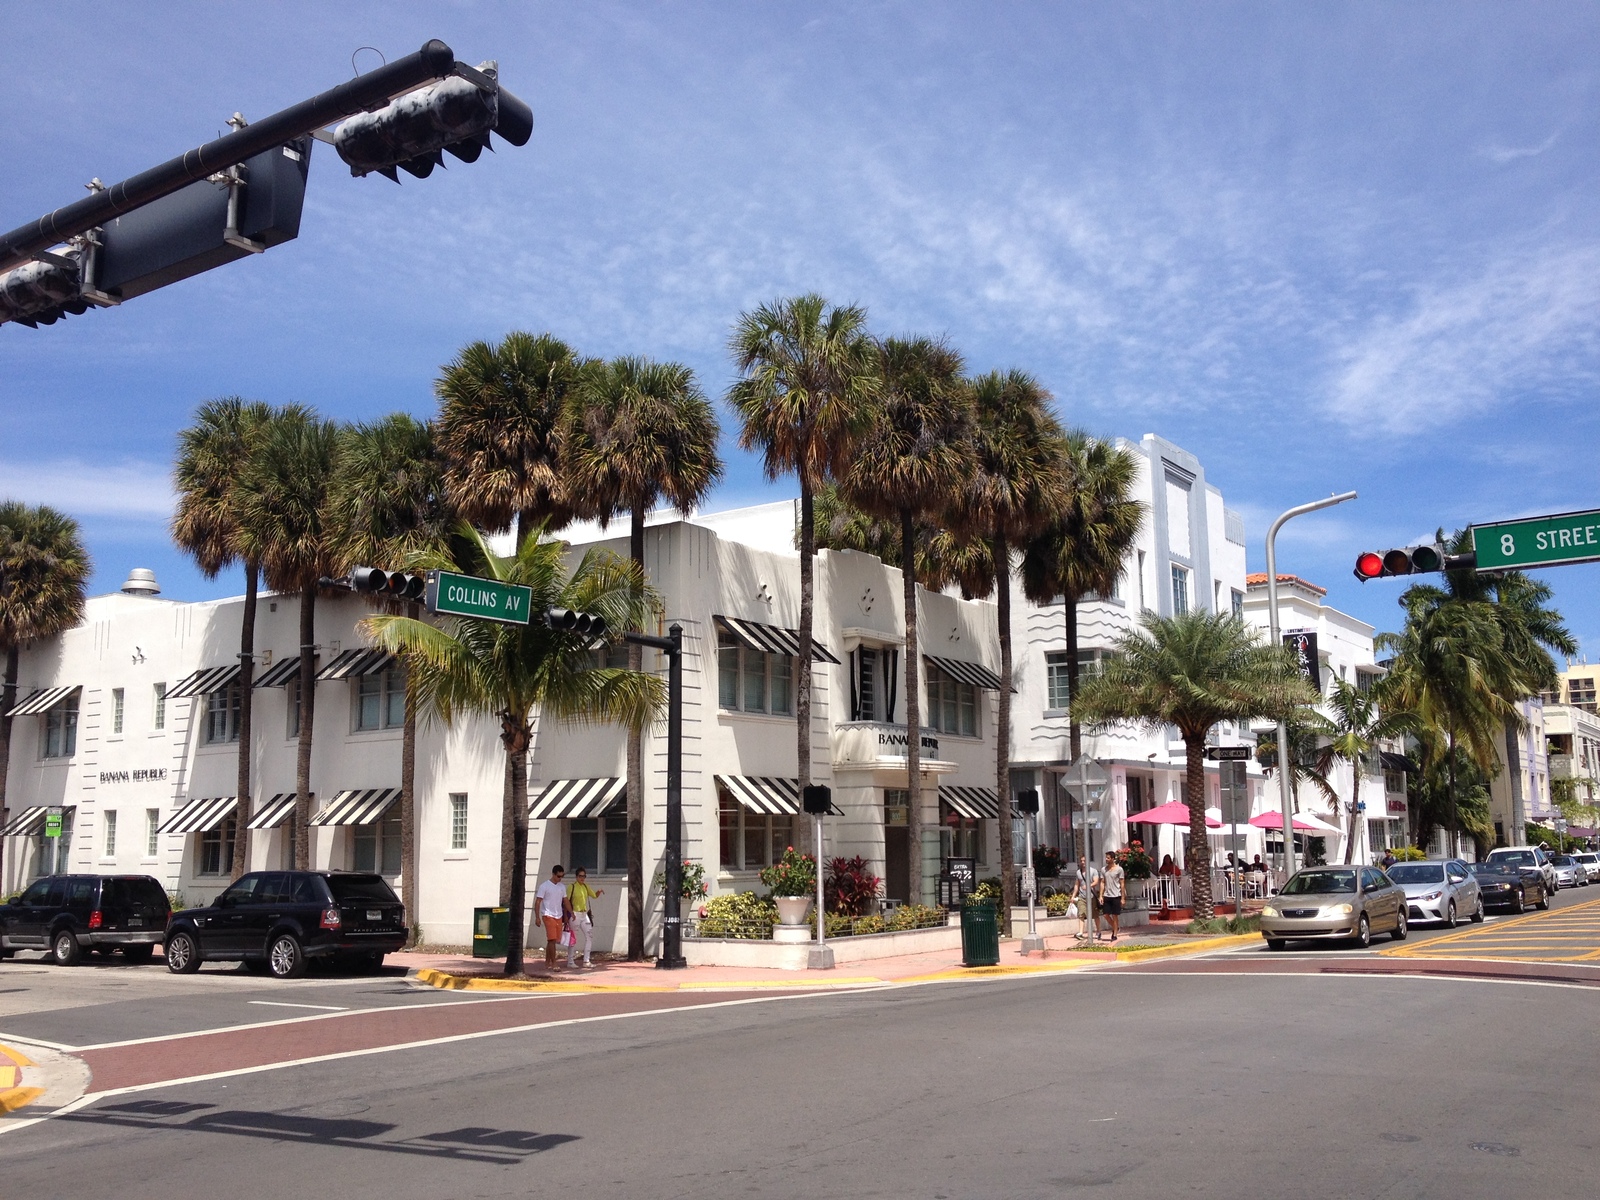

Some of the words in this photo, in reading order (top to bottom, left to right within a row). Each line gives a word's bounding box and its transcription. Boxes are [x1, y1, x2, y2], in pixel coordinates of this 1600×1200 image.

[1500, 534, 1515, 556] 8
[448, 585, 497, 608] COLLINS
[505, 595, 520, 611] AV
[1220, 750, 1231, 758] ONE
[100, 771, 129, 783] BANANA
[132, 768, 167, 781] REPUBLIC
